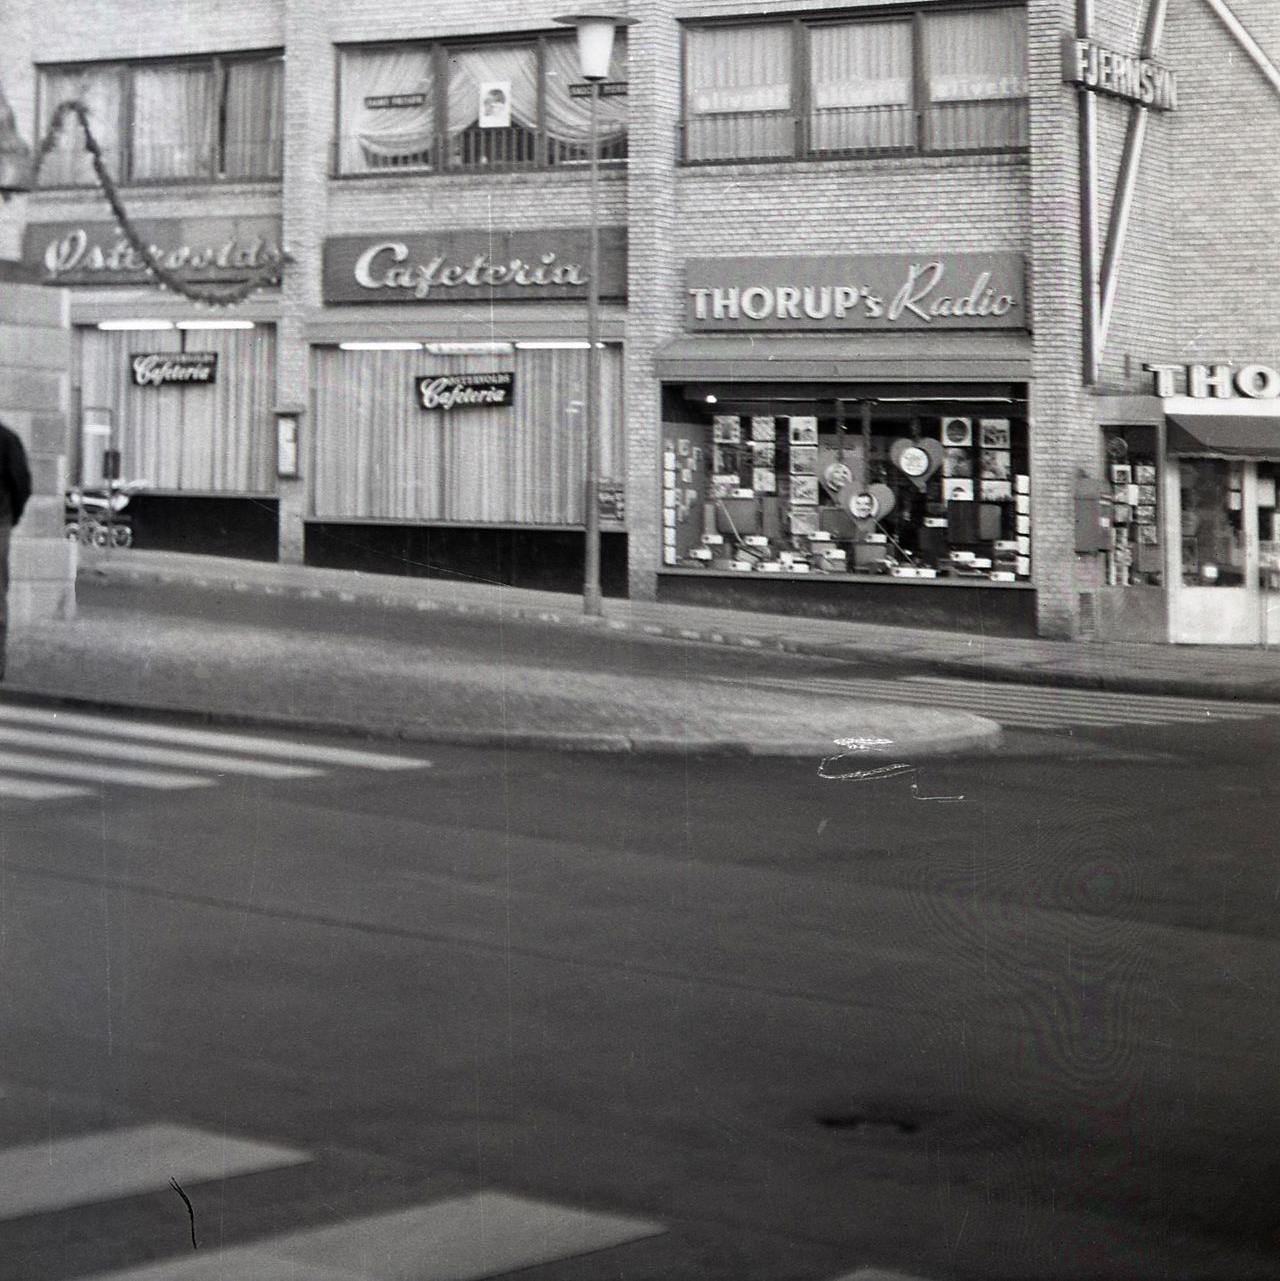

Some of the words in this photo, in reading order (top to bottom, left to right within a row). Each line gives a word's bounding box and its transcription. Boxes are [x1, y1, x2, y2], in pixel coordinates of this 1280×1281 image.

[1075, 41, 1178, 107] FJERNSYN
[355, 243, 588, 299] Cafeteria
[689, 284, 883, 320] THORUP's
[888, 260, 1016, 322] Radio
[133, 355, 210, 386] Cafeteria
[421, 377, 506, 410] Cafeteria
